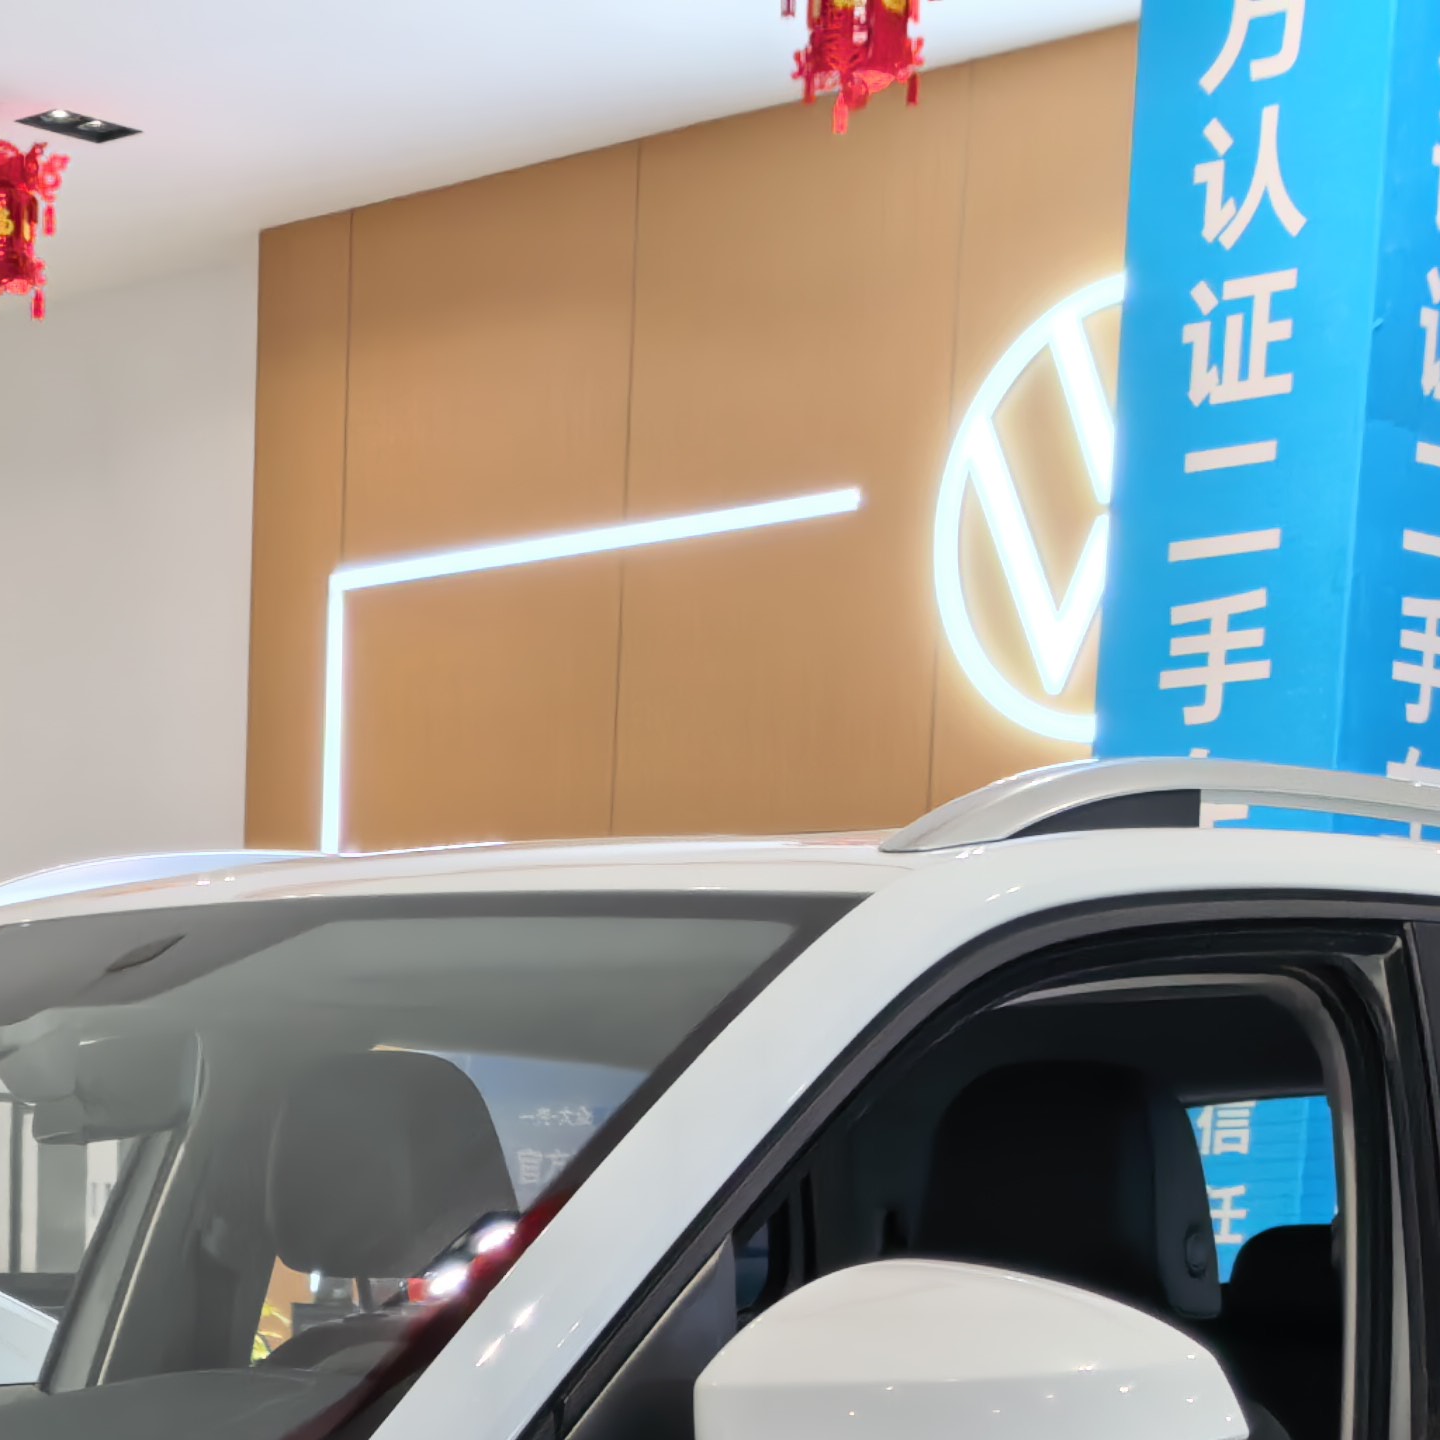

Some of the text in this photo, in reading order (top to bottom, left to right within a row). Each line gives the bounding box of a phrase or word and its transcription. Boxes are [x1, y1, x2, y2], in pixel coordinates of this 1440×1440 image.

[1160, 0, 1307, 828] 方认证二手
